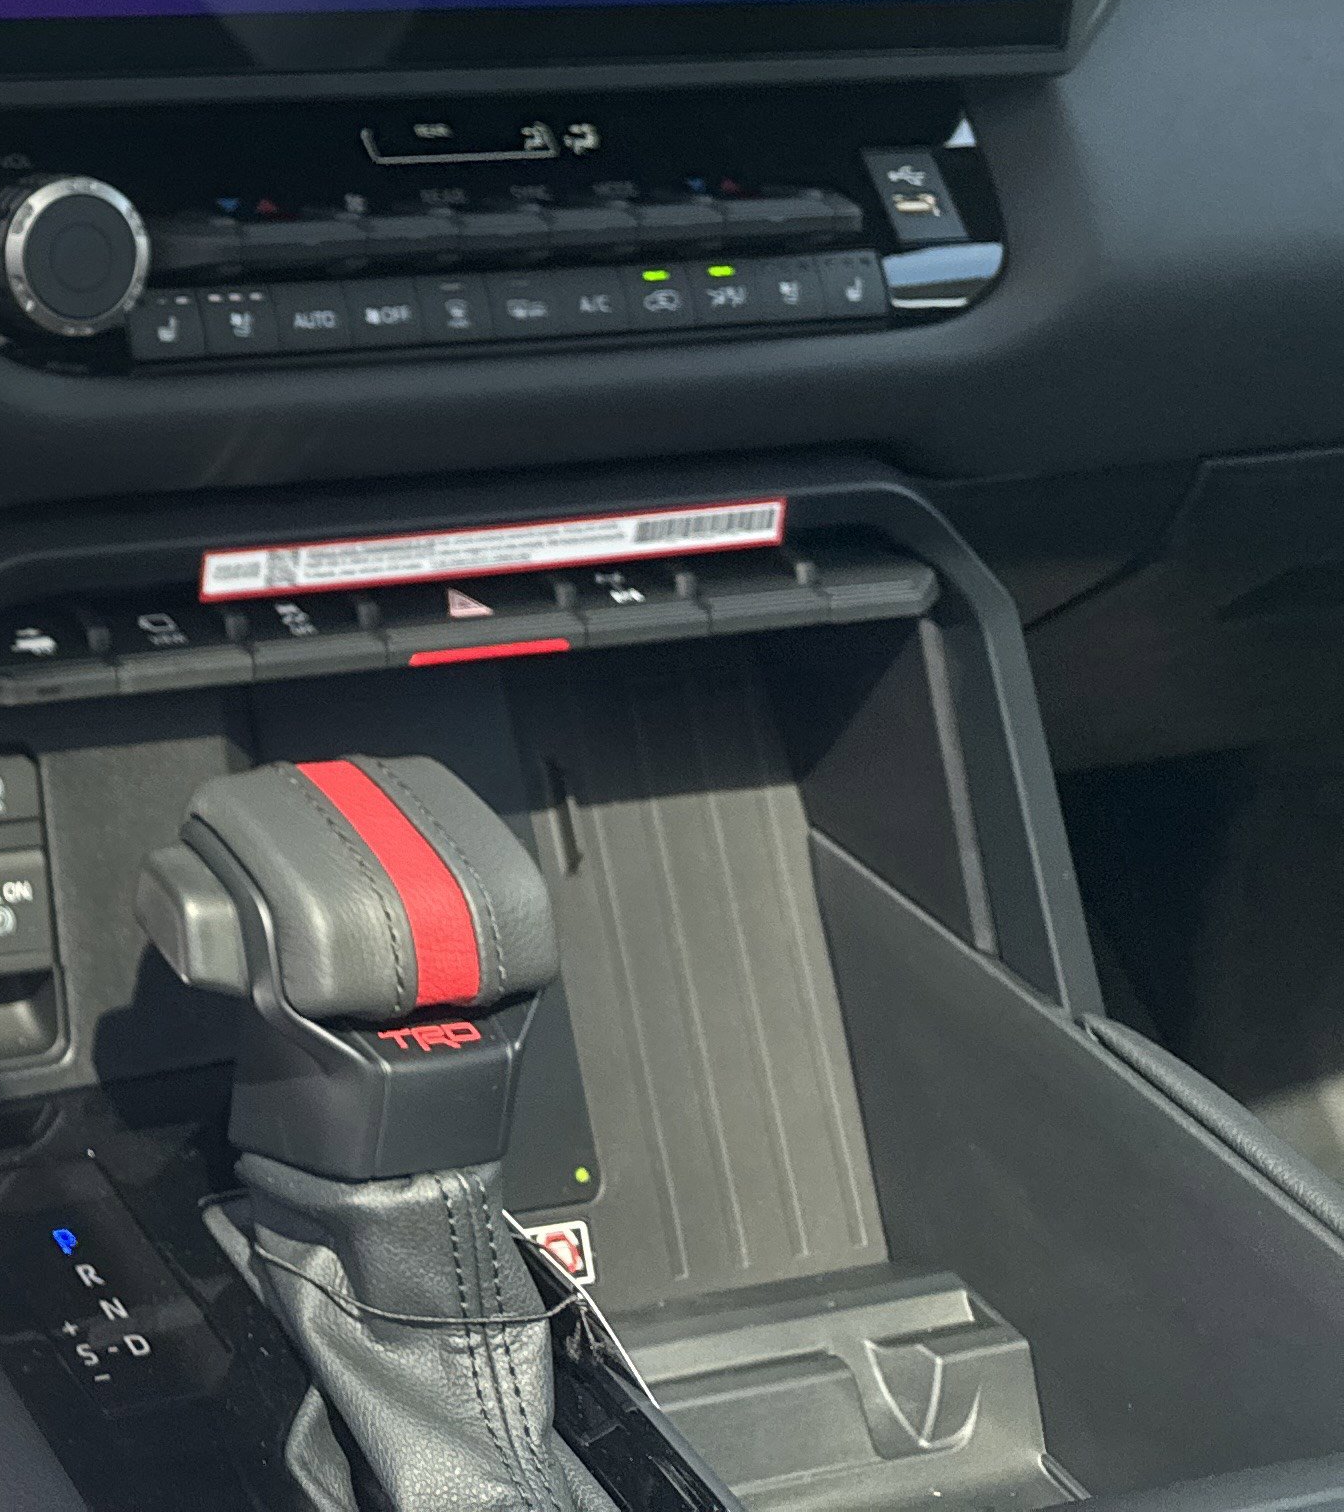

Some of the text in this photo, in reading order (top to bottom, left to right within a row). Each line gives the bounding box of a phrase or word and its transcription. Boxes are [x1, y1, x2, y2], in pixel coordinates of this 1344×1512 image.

[579, 294, 613, 314] A/C
[293, 309, 338, 329] AUTO
[2, 880, 34, 904] ON
[377, 1020, 482, 1052] TRD
[52, 1228, 78, 1256] P
[74, 1263, 107, 1288] R
[98, 1296, 130, 1321] N
[75, 1342, 100, 1367] S
[123, 1333, 152, 1357] D
